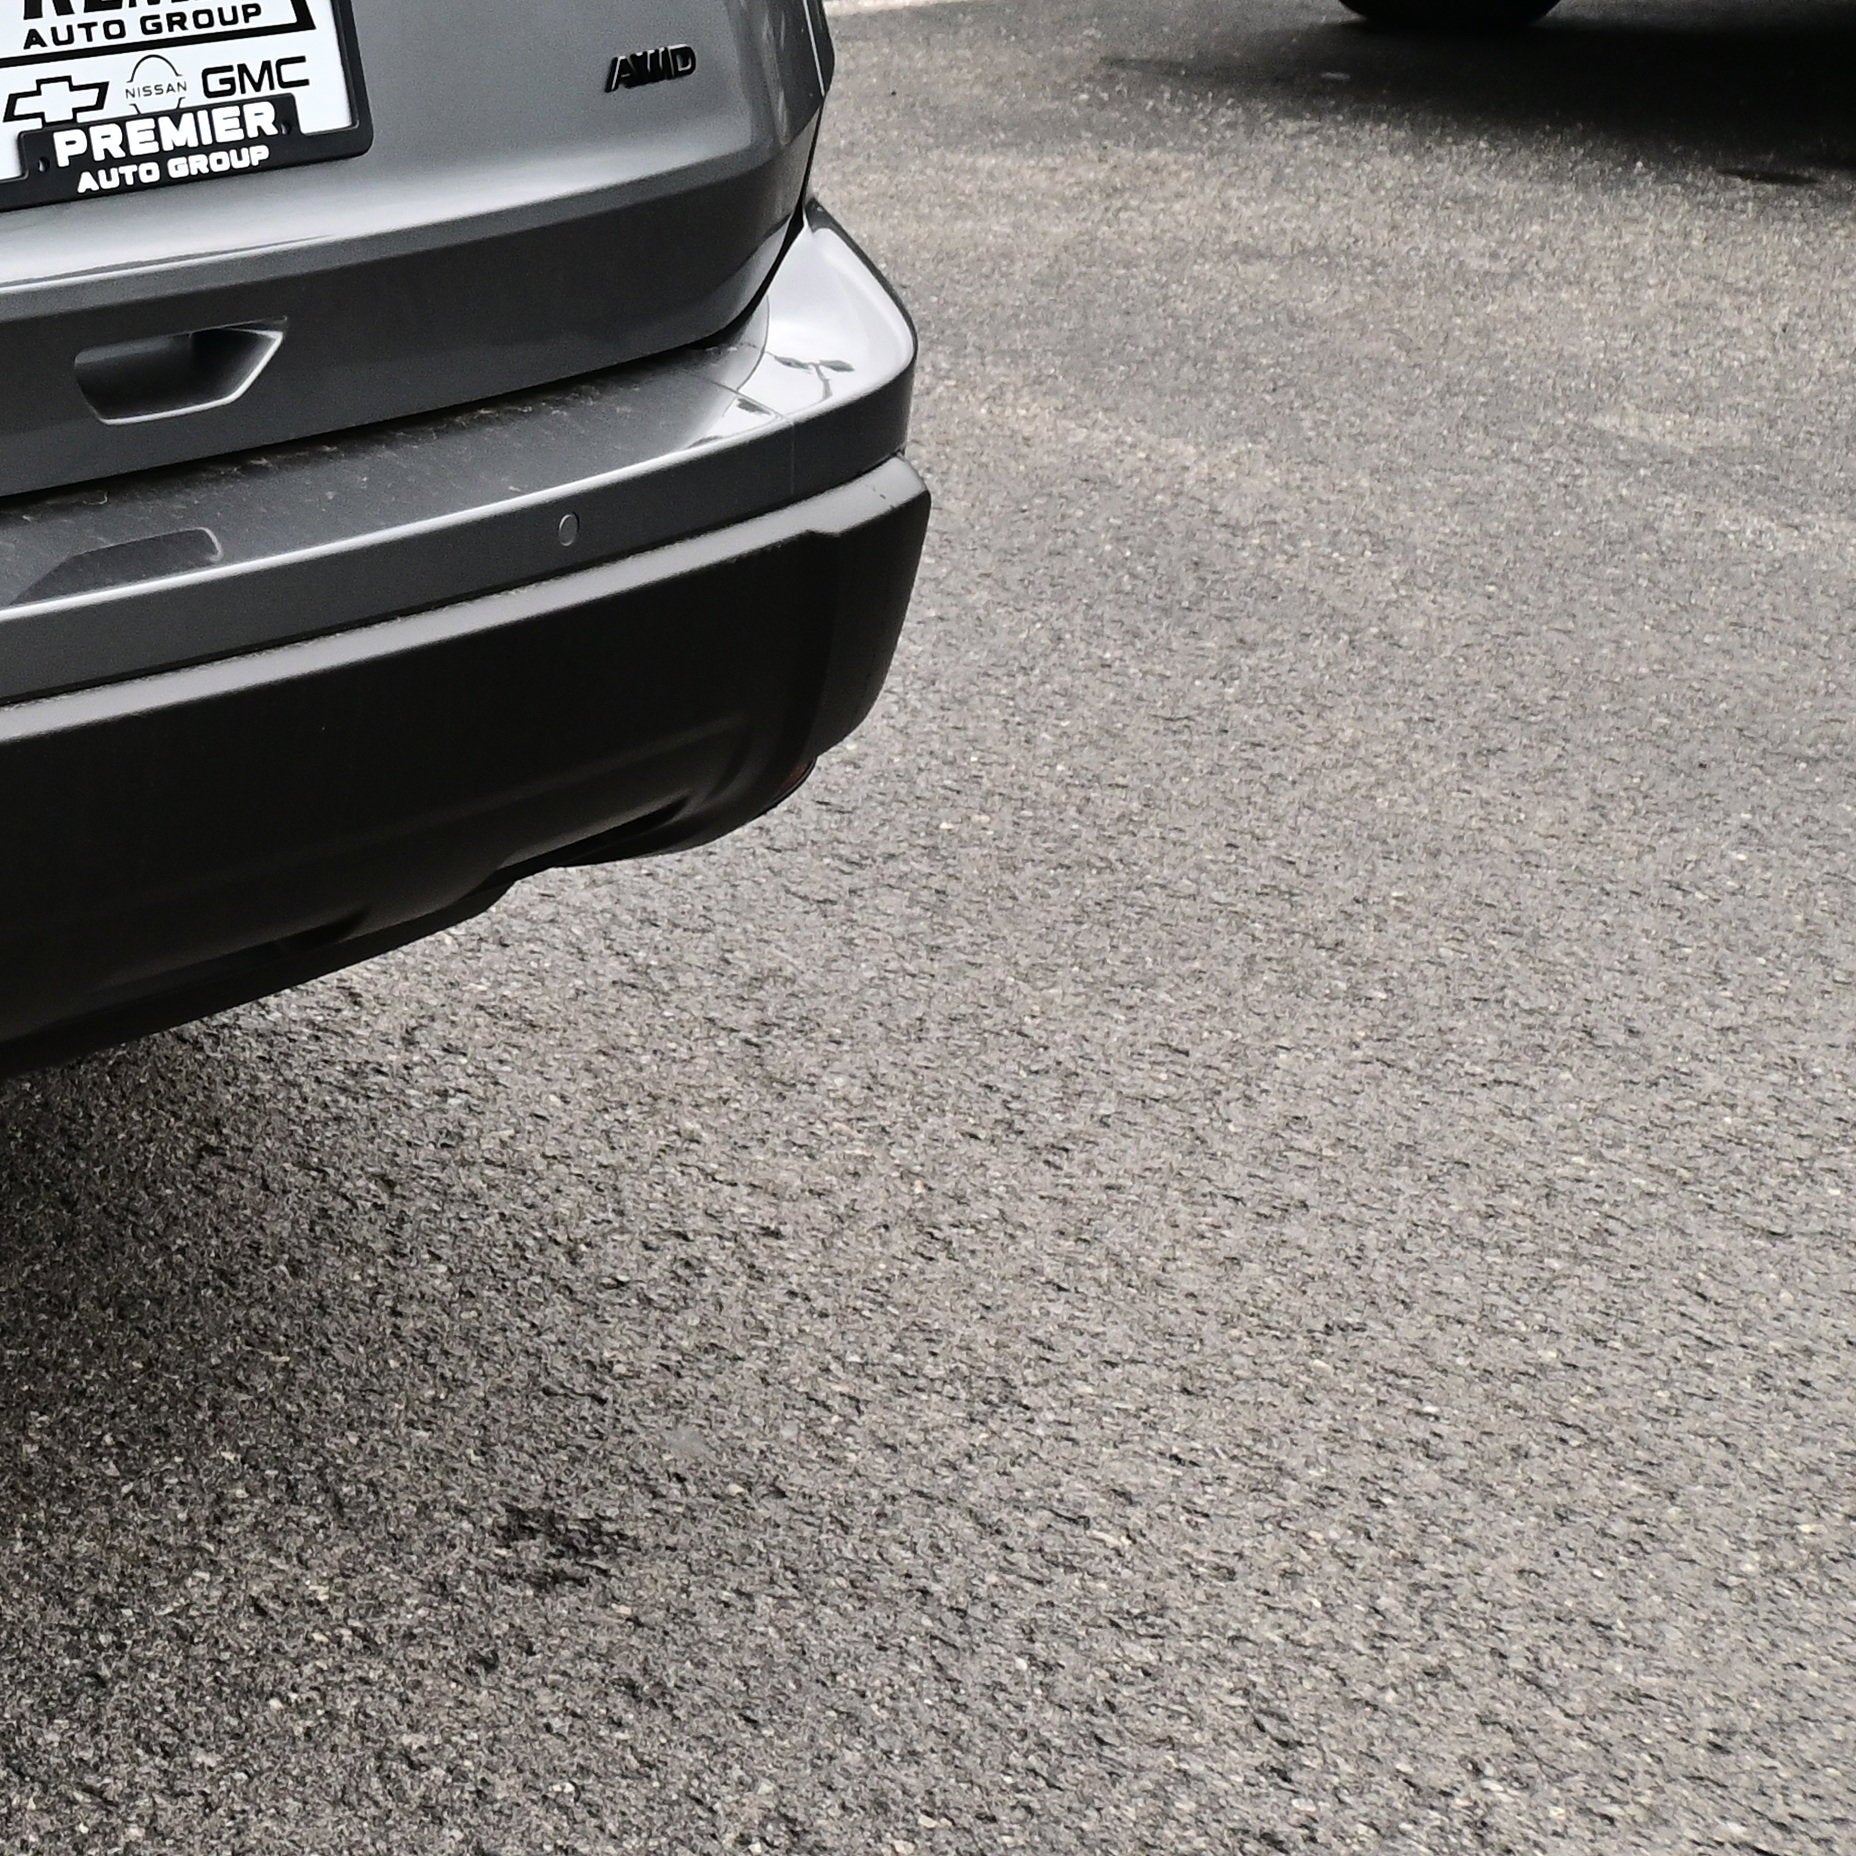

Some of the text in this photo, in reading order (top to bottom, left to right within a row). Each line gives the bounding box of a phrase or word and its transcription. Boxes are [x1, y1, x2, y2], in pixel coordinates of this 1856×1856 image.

[23, 2, 263, 50] AUTO GROUP
[124, 80, 188, 100] NISSAN
[202, 55, 310, 99] GMC
[604, 44, 696, 93] AWD
[53, 100, 279, 168] PREMIER
[76, 145, 270, 194] AUTO GROUP
